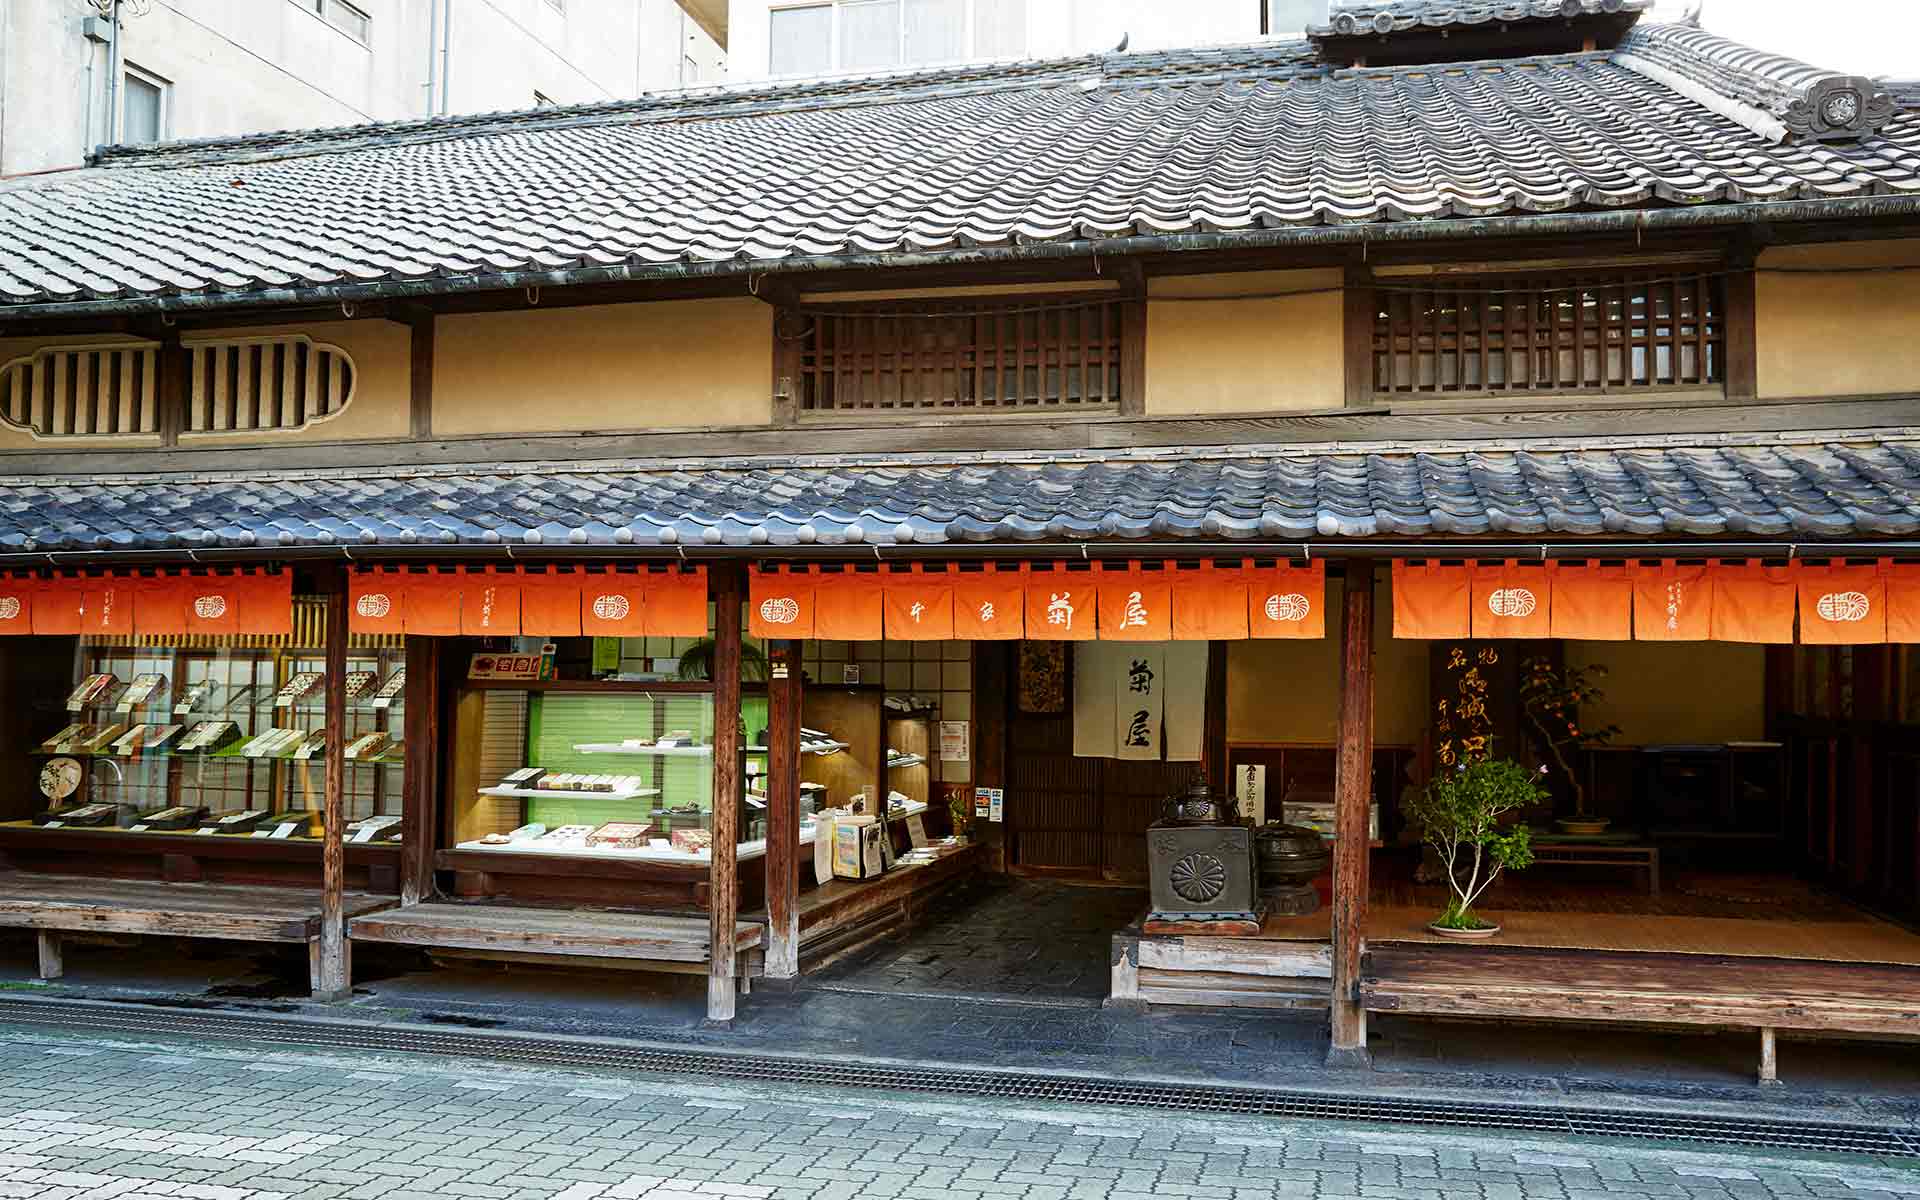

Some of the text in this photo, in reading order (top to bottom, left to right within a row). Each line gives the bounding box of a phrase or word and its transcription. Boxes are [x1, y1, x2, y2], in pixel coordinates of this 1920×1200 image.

[910, 591, 1148, 631] 本家菊屋
[1125, 659, 1155, 747] 菊屋
